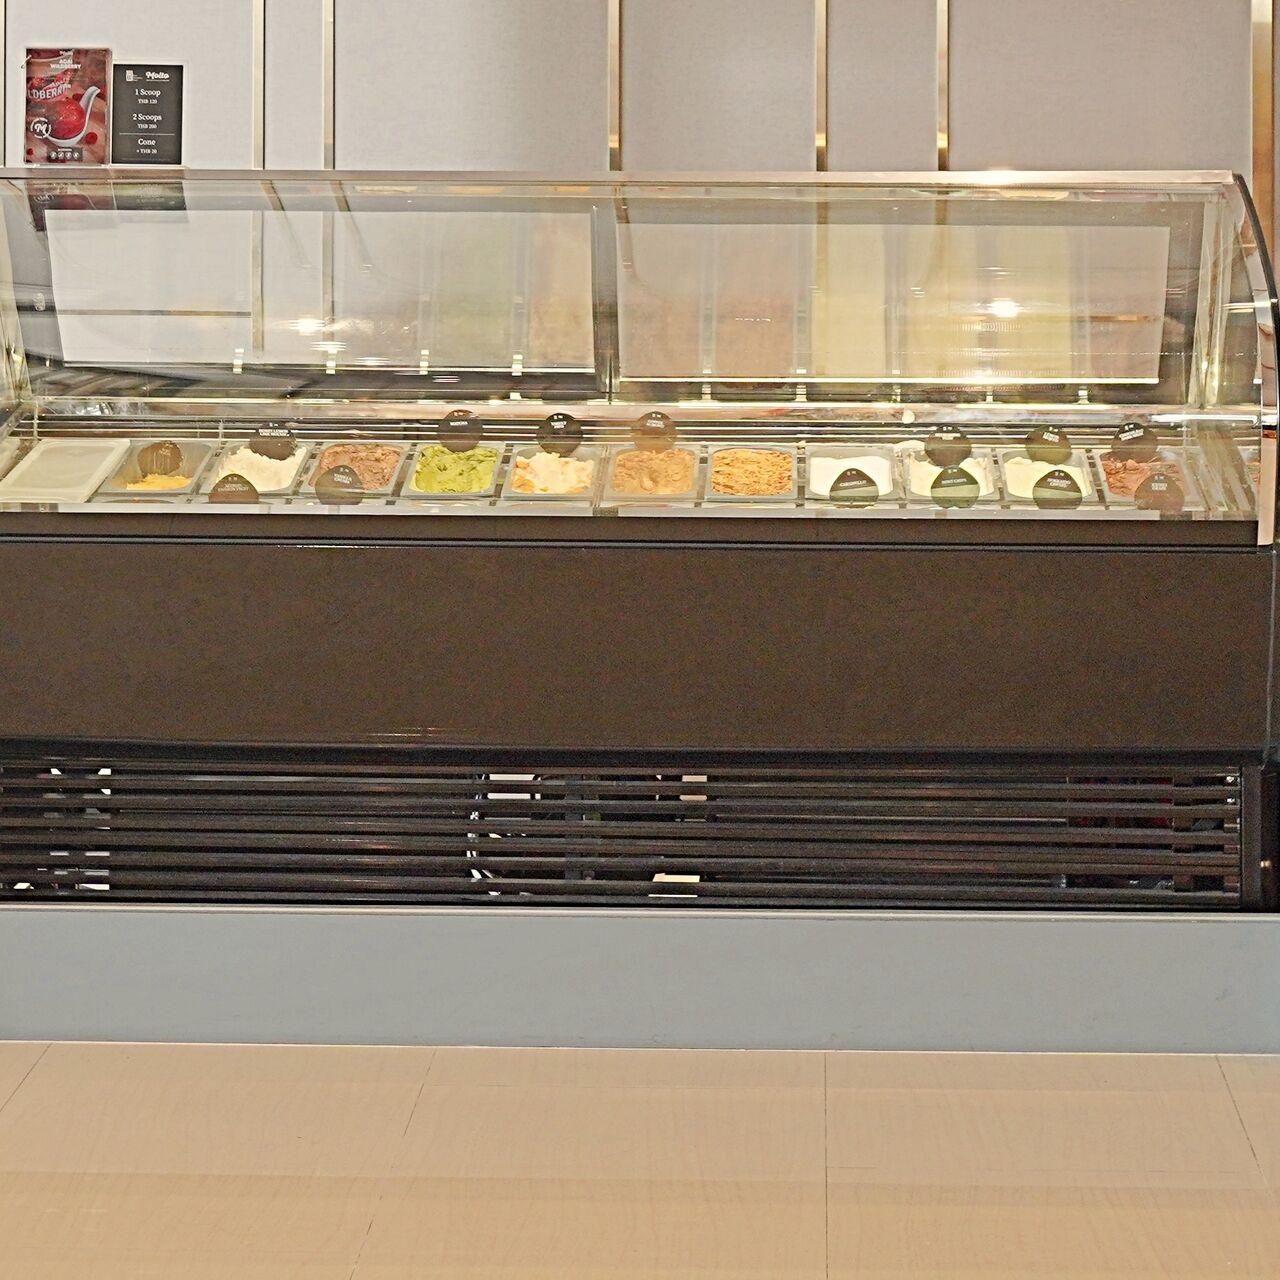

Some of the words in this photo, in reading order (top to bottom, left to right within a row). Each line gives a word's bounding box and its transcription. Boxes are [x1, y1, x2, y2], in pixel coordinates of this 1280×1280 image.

[145, 71, 170, 80] Molto
[140, 88, 161, 98] Scoop
[132, 113, 137, 121] 2
[138, 113, 162, 122] Scoops
[138, 138, 156, 146] Cone
